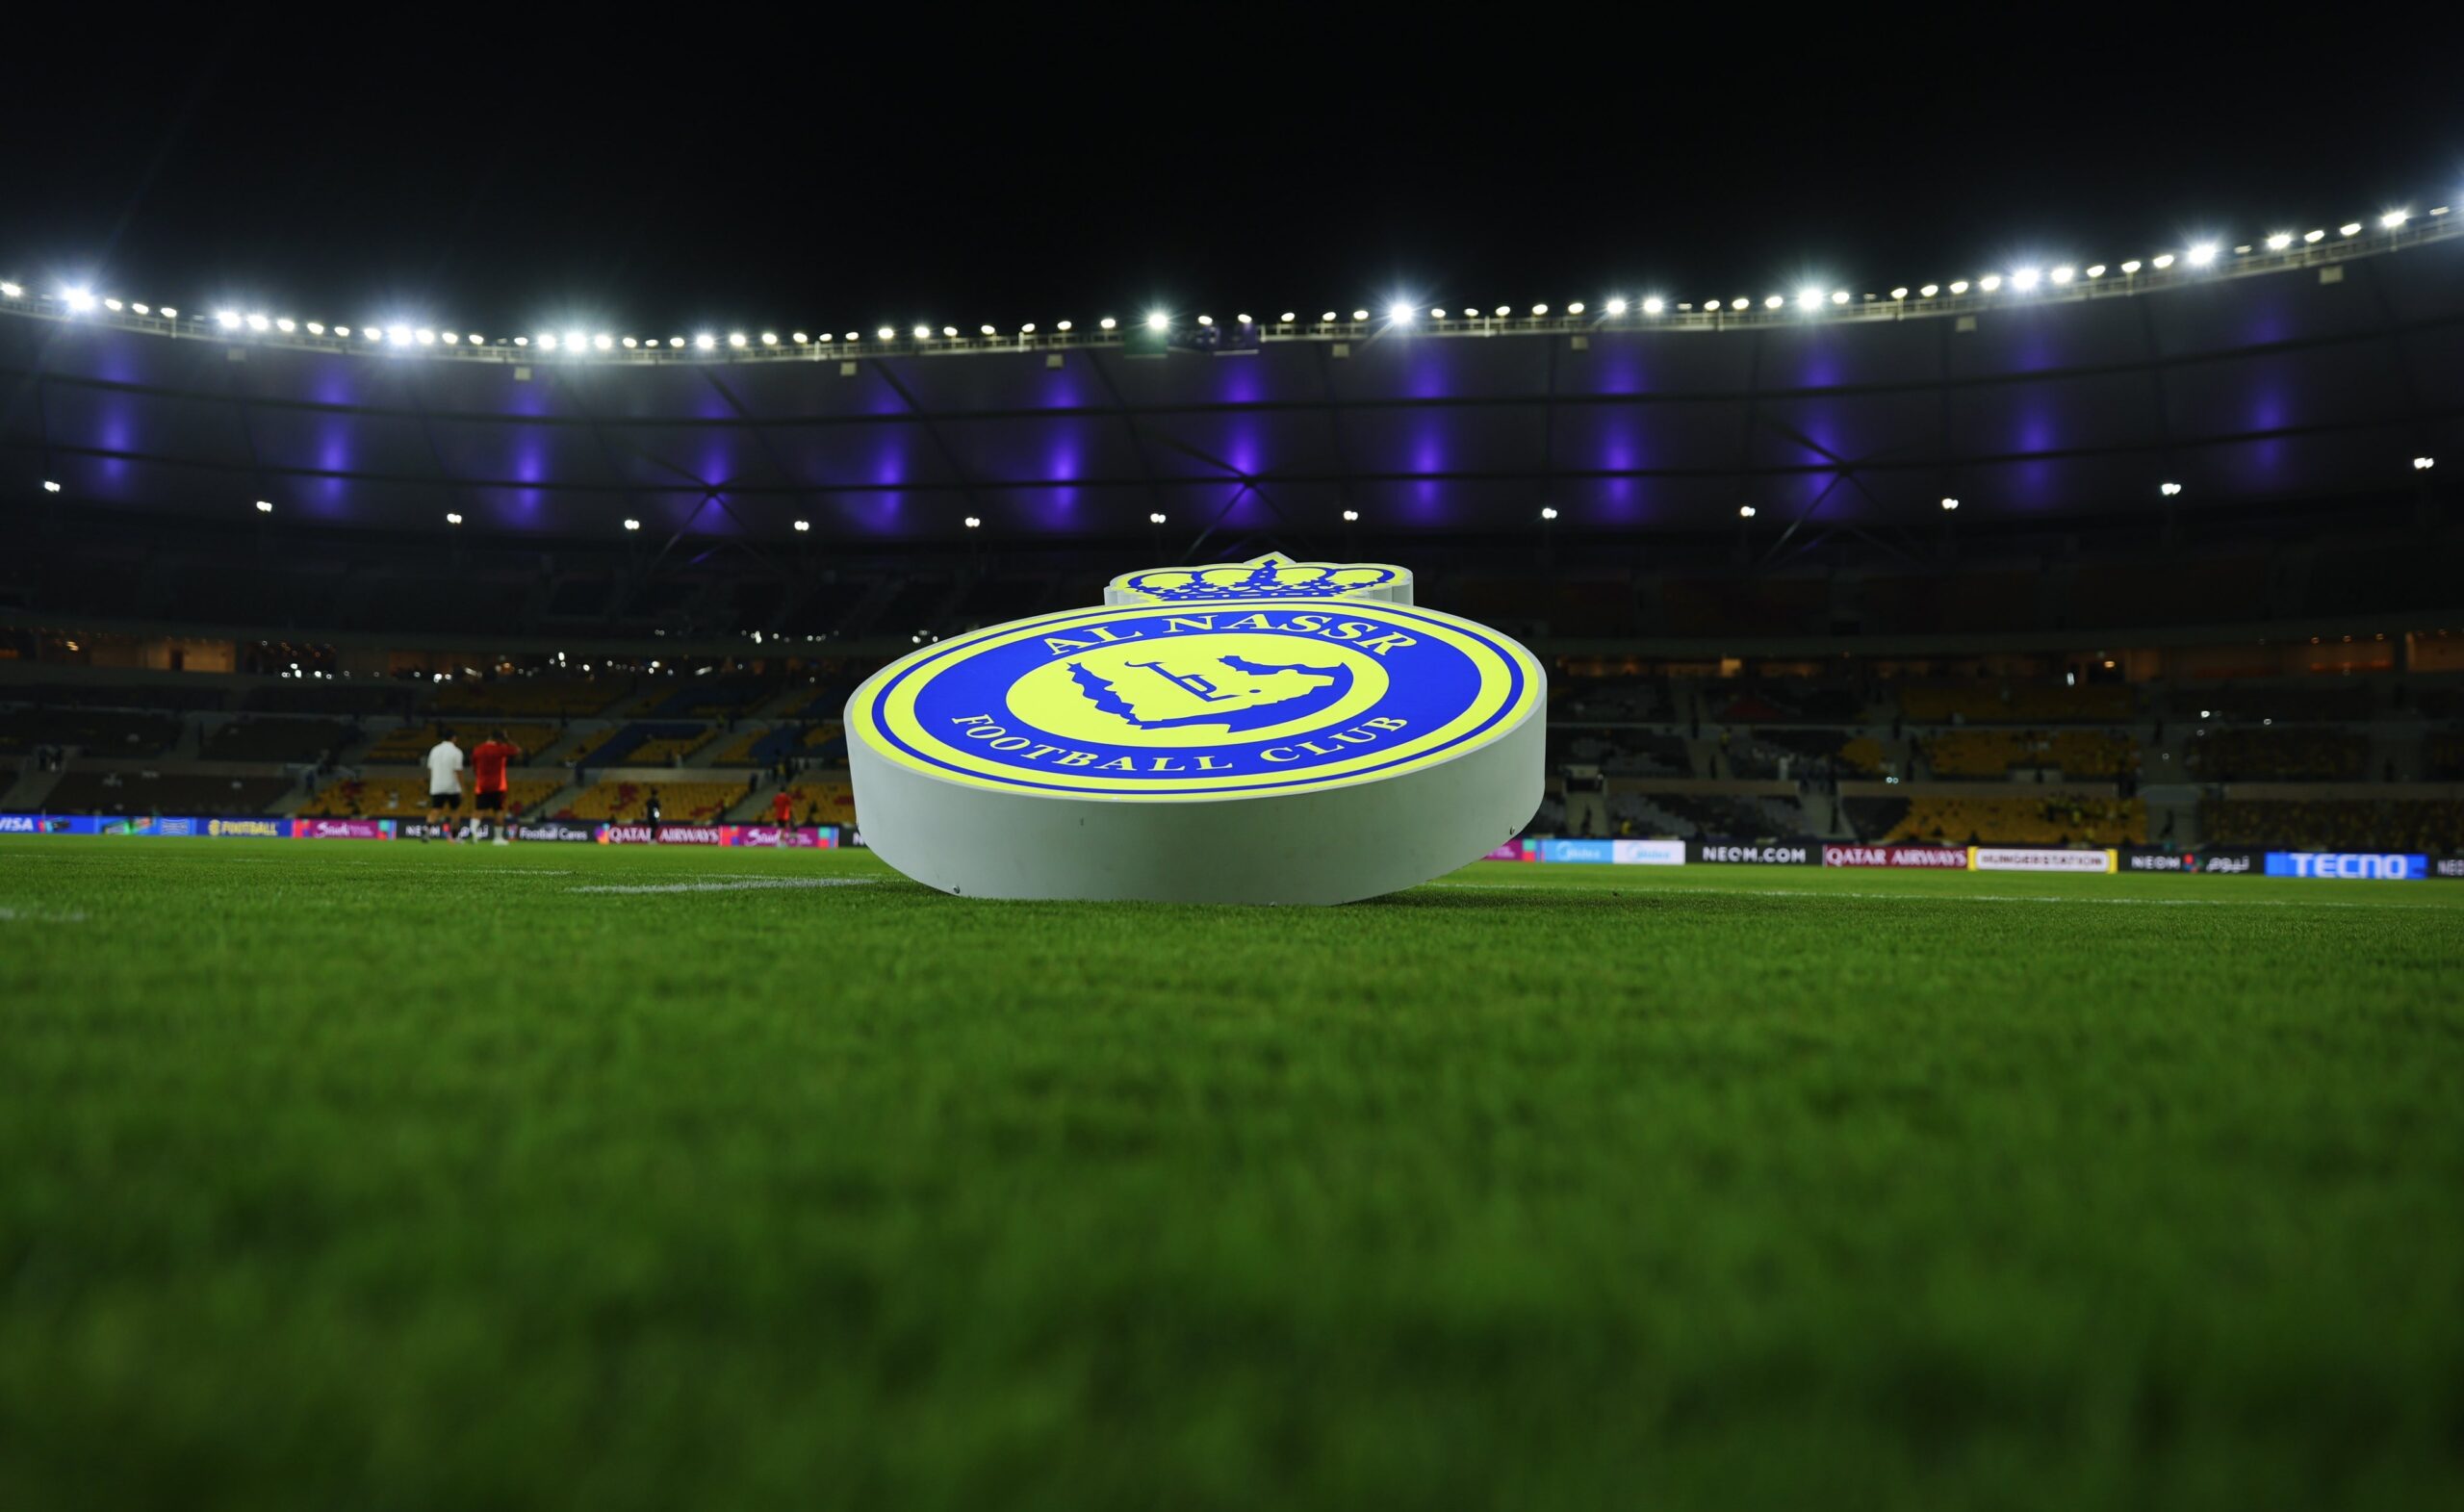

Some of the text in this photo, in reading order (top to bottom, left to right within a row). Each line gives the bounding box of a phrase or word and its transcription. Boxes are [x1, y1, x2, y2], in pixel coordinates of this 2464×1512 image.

[1042, 613, 1419, 655] AL NASSR
[952, 713, 1409, 772] FOOTBALL CLUB
[0, 816, 33, 832] VISA
[659, 828, 719, 843] AIRWAYS
[1703, 847, 1807, 863] NEOM.COM
[1826, 848, 1966, 866] QATAR AIRWAYS
[2131, 856, 2181, 869] NEOM
[2290, 854, 2407, 880] TECNO
